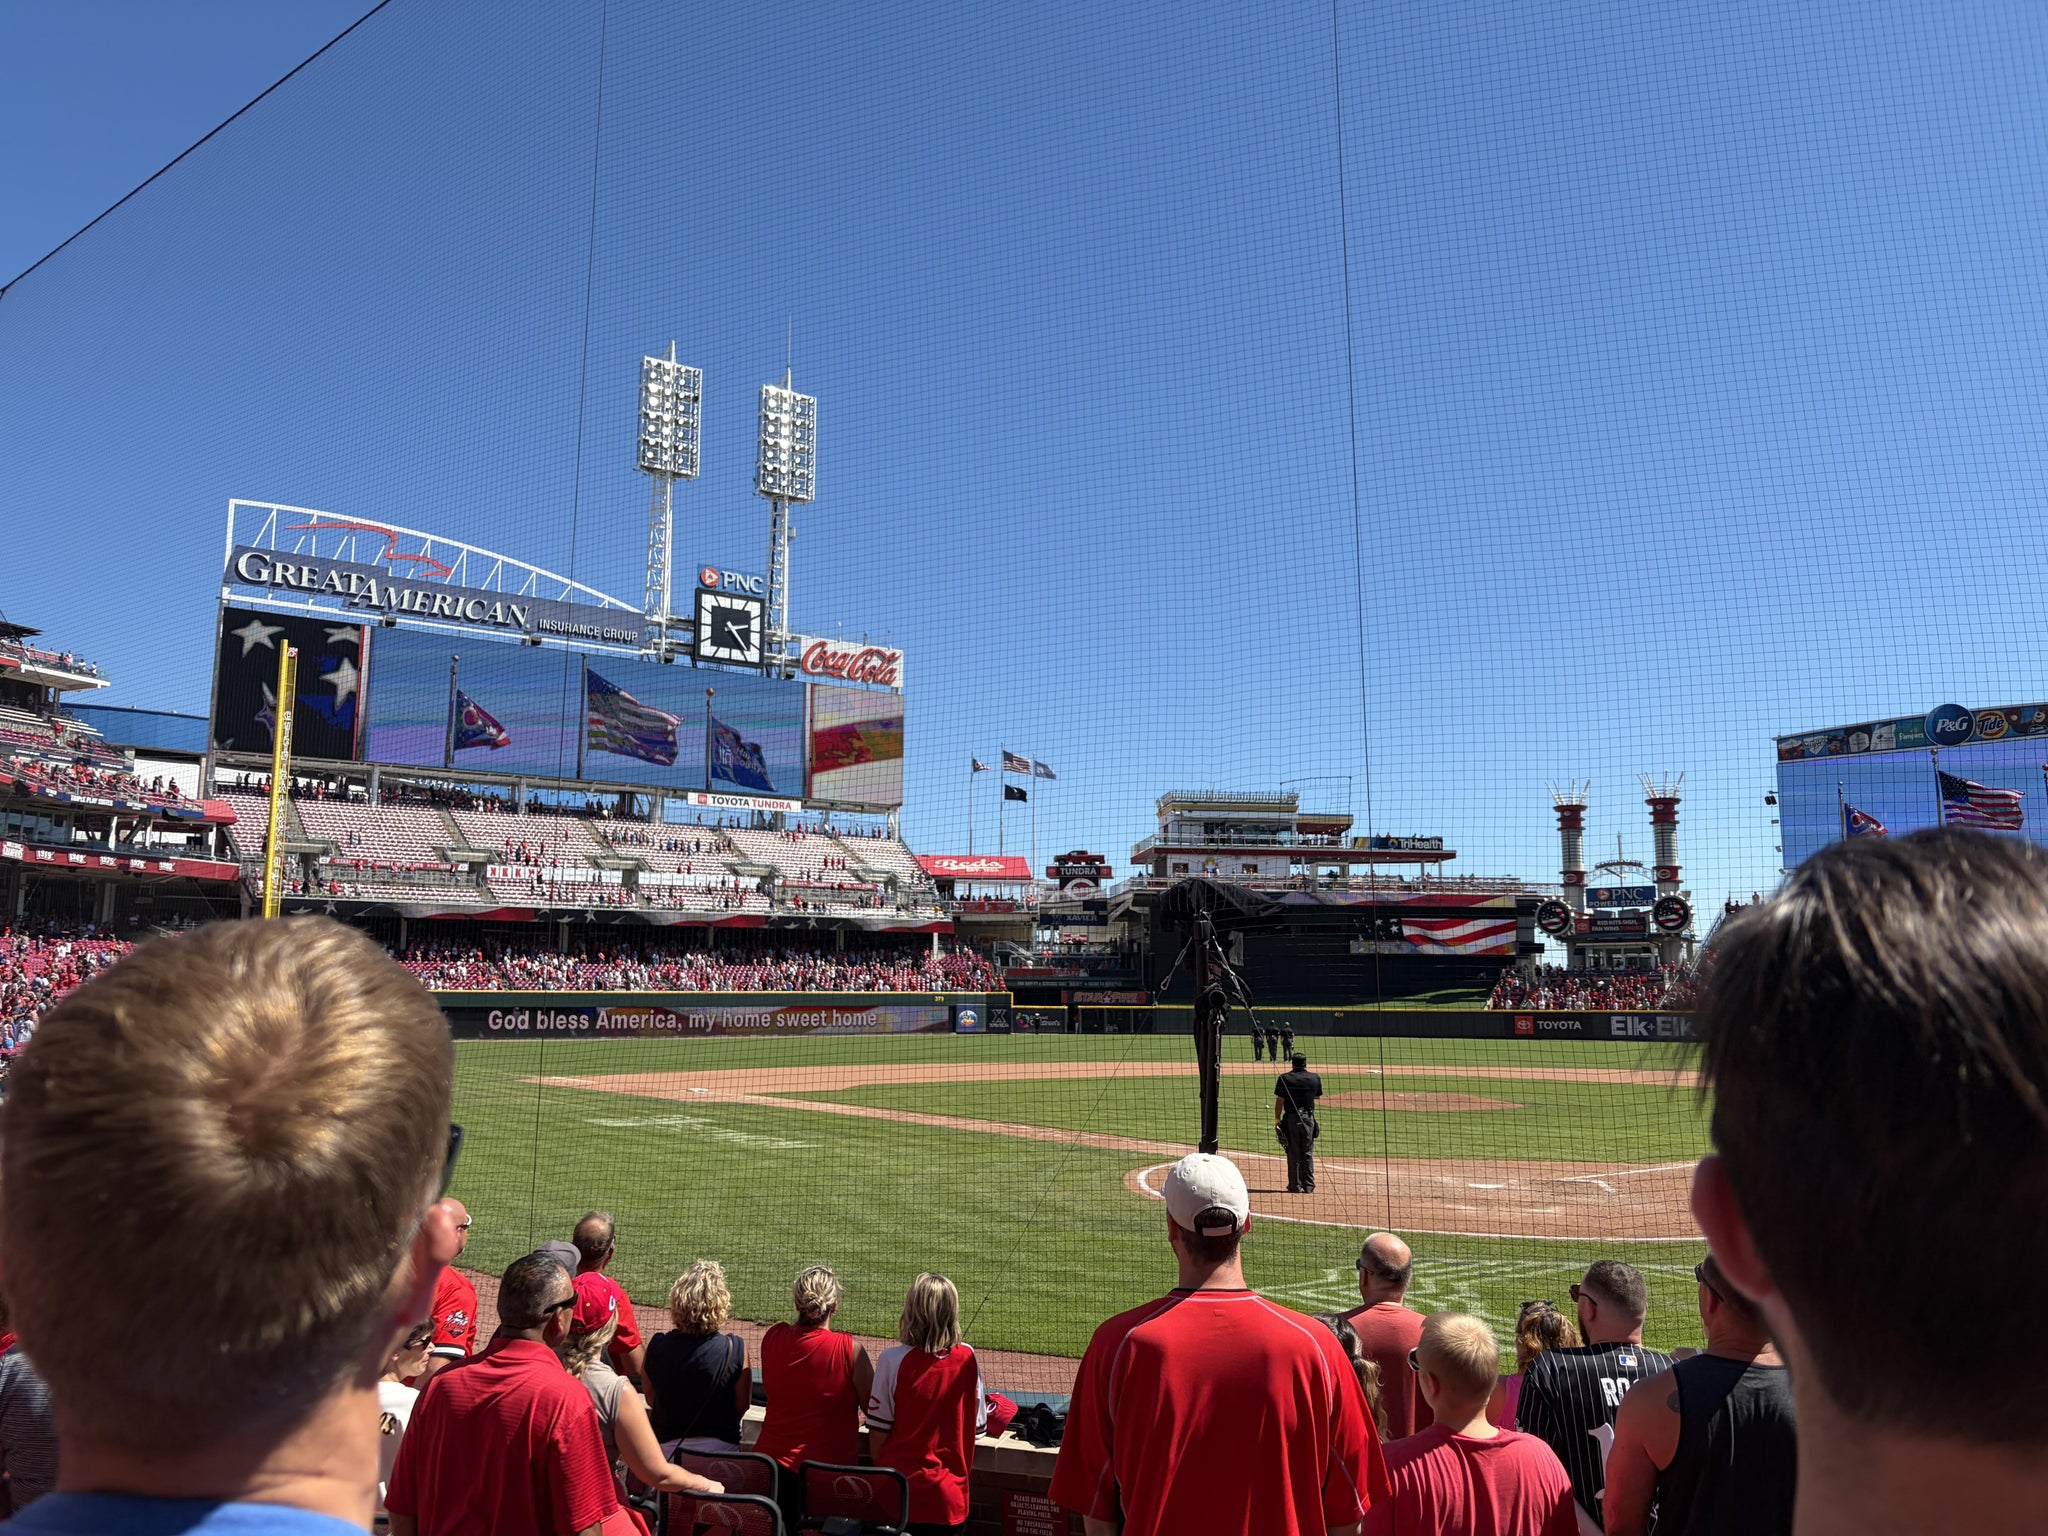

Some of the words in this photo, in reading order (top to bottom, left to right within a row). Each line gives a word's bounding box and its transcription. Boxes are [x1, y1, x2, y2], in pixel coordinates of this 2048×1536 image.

[722, 569, 764, 594] PNC
[235, 551, 366, 597] GREAT
[350, 577, 531, 629] AMERICAN
[538, 618, 600, 637] INSURANCE
[603, 627, 638, 643] GROUP
[1936, 717, 1968, 733] P&G
[1977, 715, 2005, 735] Tide
[711, 795, 750, 807] TOYOTA
[752, 799, 792, 810] TUNDRA
[1399, 838, 1442, 849] TriHealth
[1060, 867, 1097, 875] TUNDRA
[1611, 888, 1644, 899] PNC
[488, 1009, 530, 1030] God
[536, 1009, 590, 1030] bless
[596, 1009, 682, 1031] America,
[689, 1011, 717, 1032] my
[722, 1009, 771, 1028] home
[776, 1010, 827, 1028] sweet
[832, 1008, 877, 1028] home
[1536, 1020, 1582, 1030] TOYOTA
